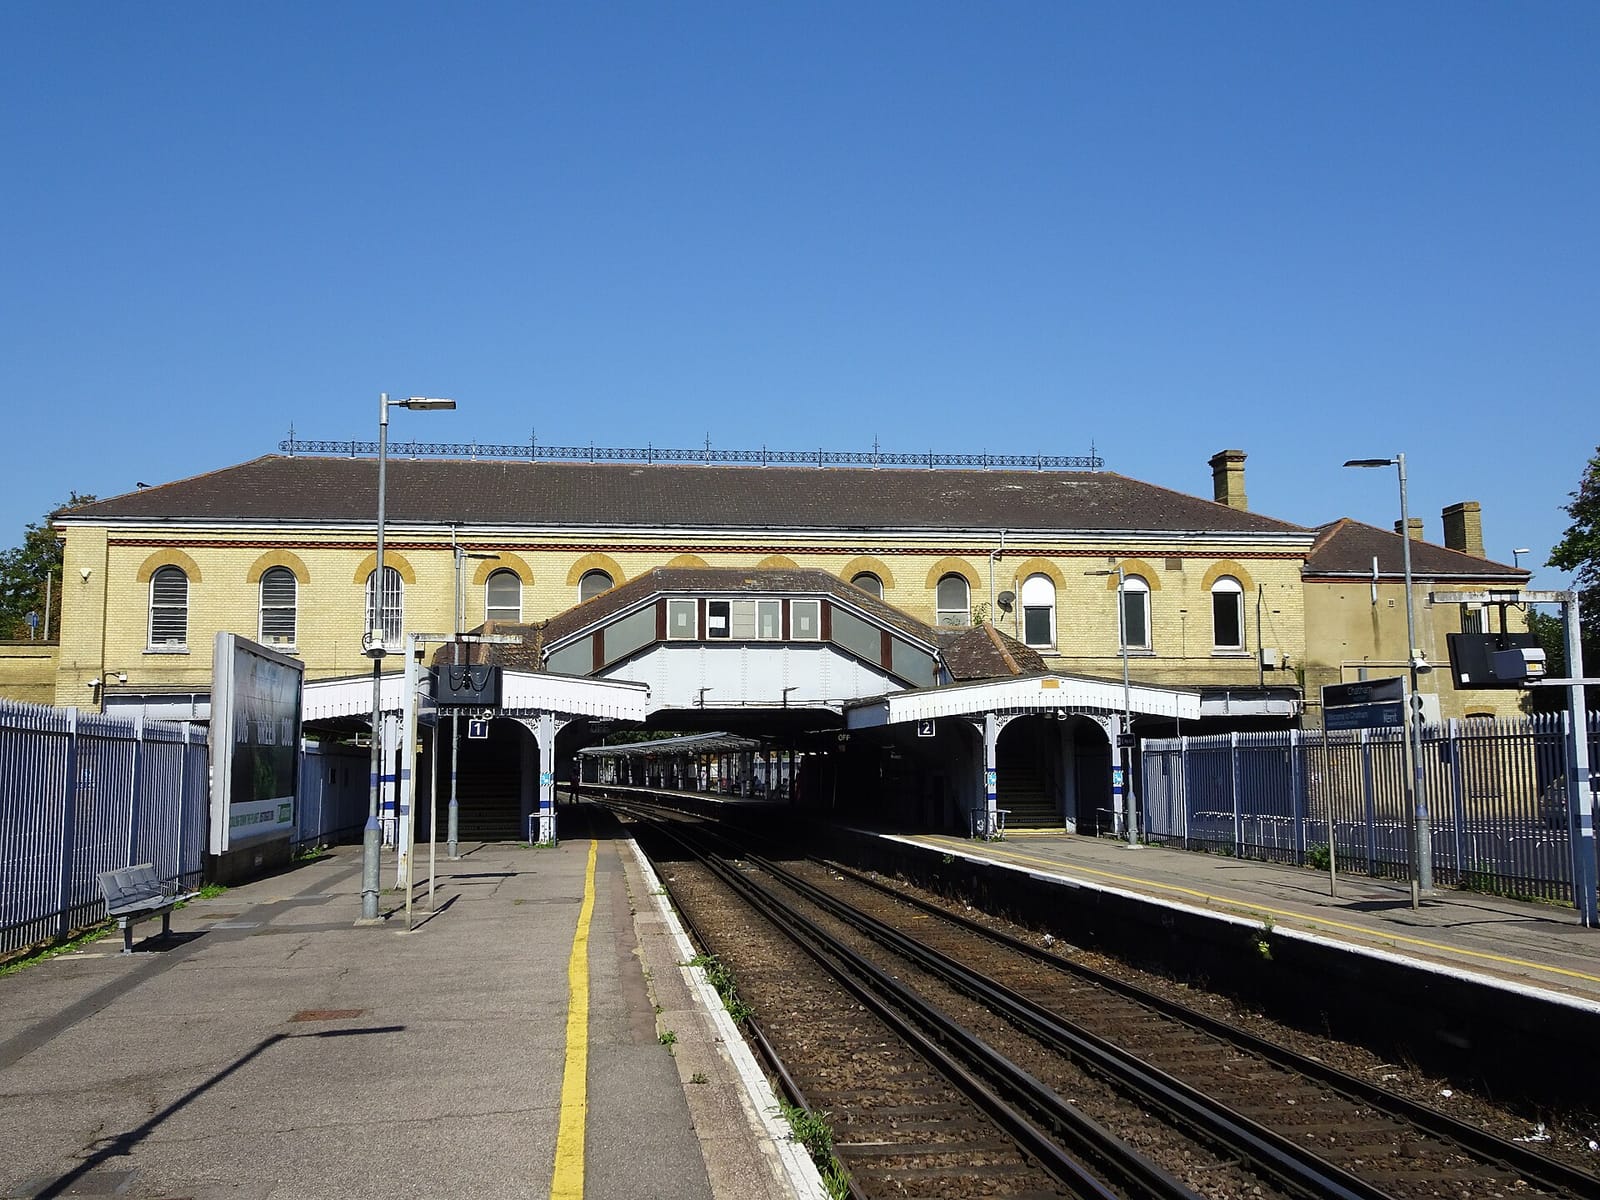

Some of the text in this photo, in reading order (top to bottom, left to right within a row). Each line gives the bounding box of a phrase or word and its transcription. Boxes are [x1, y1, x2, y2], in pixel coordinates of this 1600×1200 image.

[474, 722, 481, 736] 1
[922, 721, 932, 735] 2
[837, 733, 851, 742] OFF
